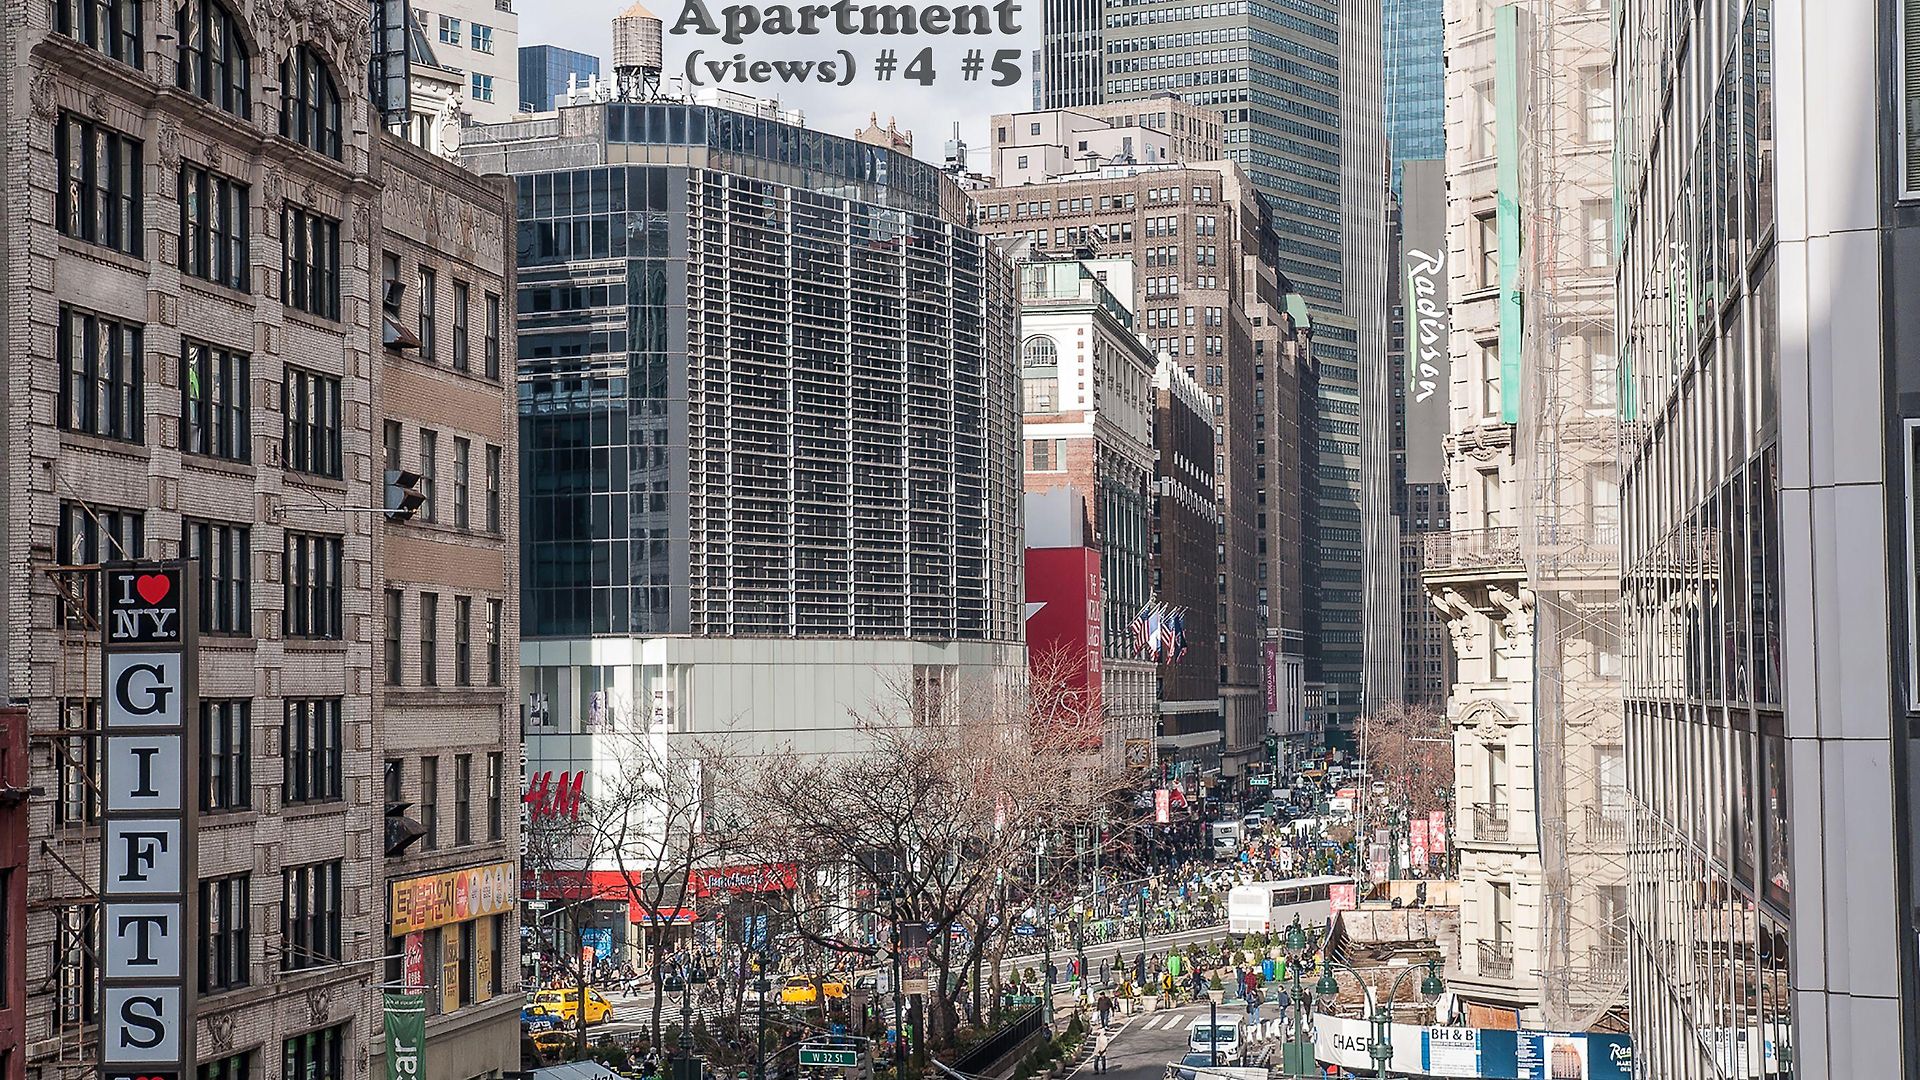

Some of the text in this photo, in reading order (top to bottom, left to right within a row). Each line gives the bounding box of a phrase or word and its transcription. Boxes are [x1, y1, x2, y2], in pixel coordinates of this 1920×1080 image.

[1406, 248, 1446, 403] Radisson
[115, 664, 174, 1050] GIFTS
[812, 1053, 843, 1063] W 32 St
[1431, 1028, 1449, 1040] BH
[1466, 1029, 1474, 1041] B
